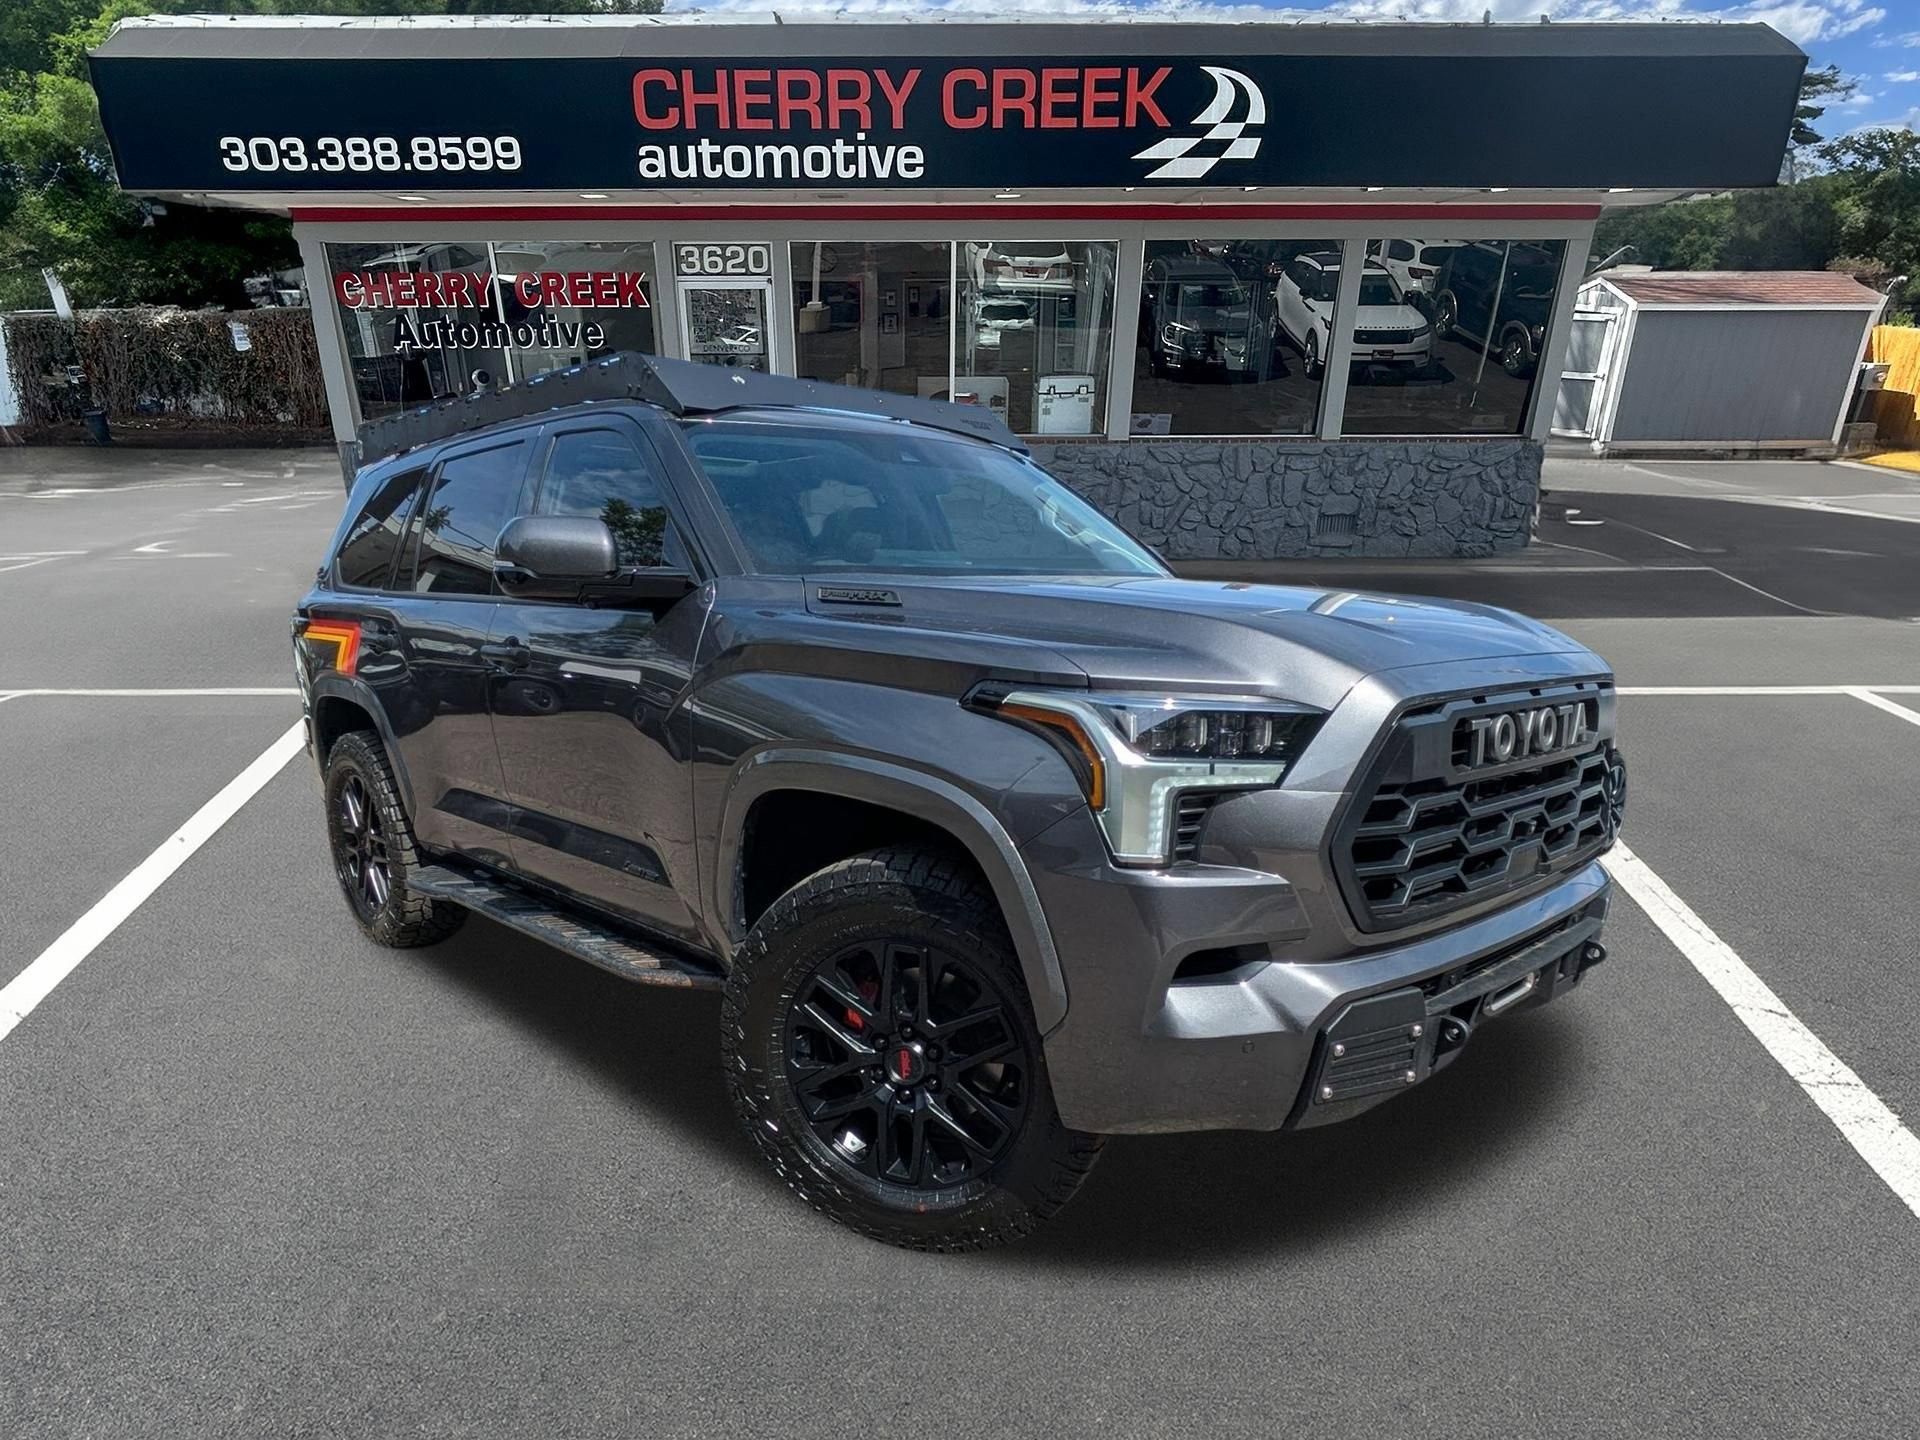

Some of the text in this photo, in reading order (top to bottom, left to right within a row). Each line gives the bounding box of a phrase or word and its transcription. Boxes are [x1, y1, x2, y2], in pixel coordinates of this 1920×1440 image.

[631, 67, 1173, 129] CHERRY CREEK
[219, 136, 522, 171] 303.388.8599
[638, 132, 924, 178] automotive
[680, 245, 769, 274] 3620
[334, 271, 651, 308] CHERRY CREEK
[394, 313, 605, 349] Automotive
[1468, 702, 1588, 768] TOYOTA
